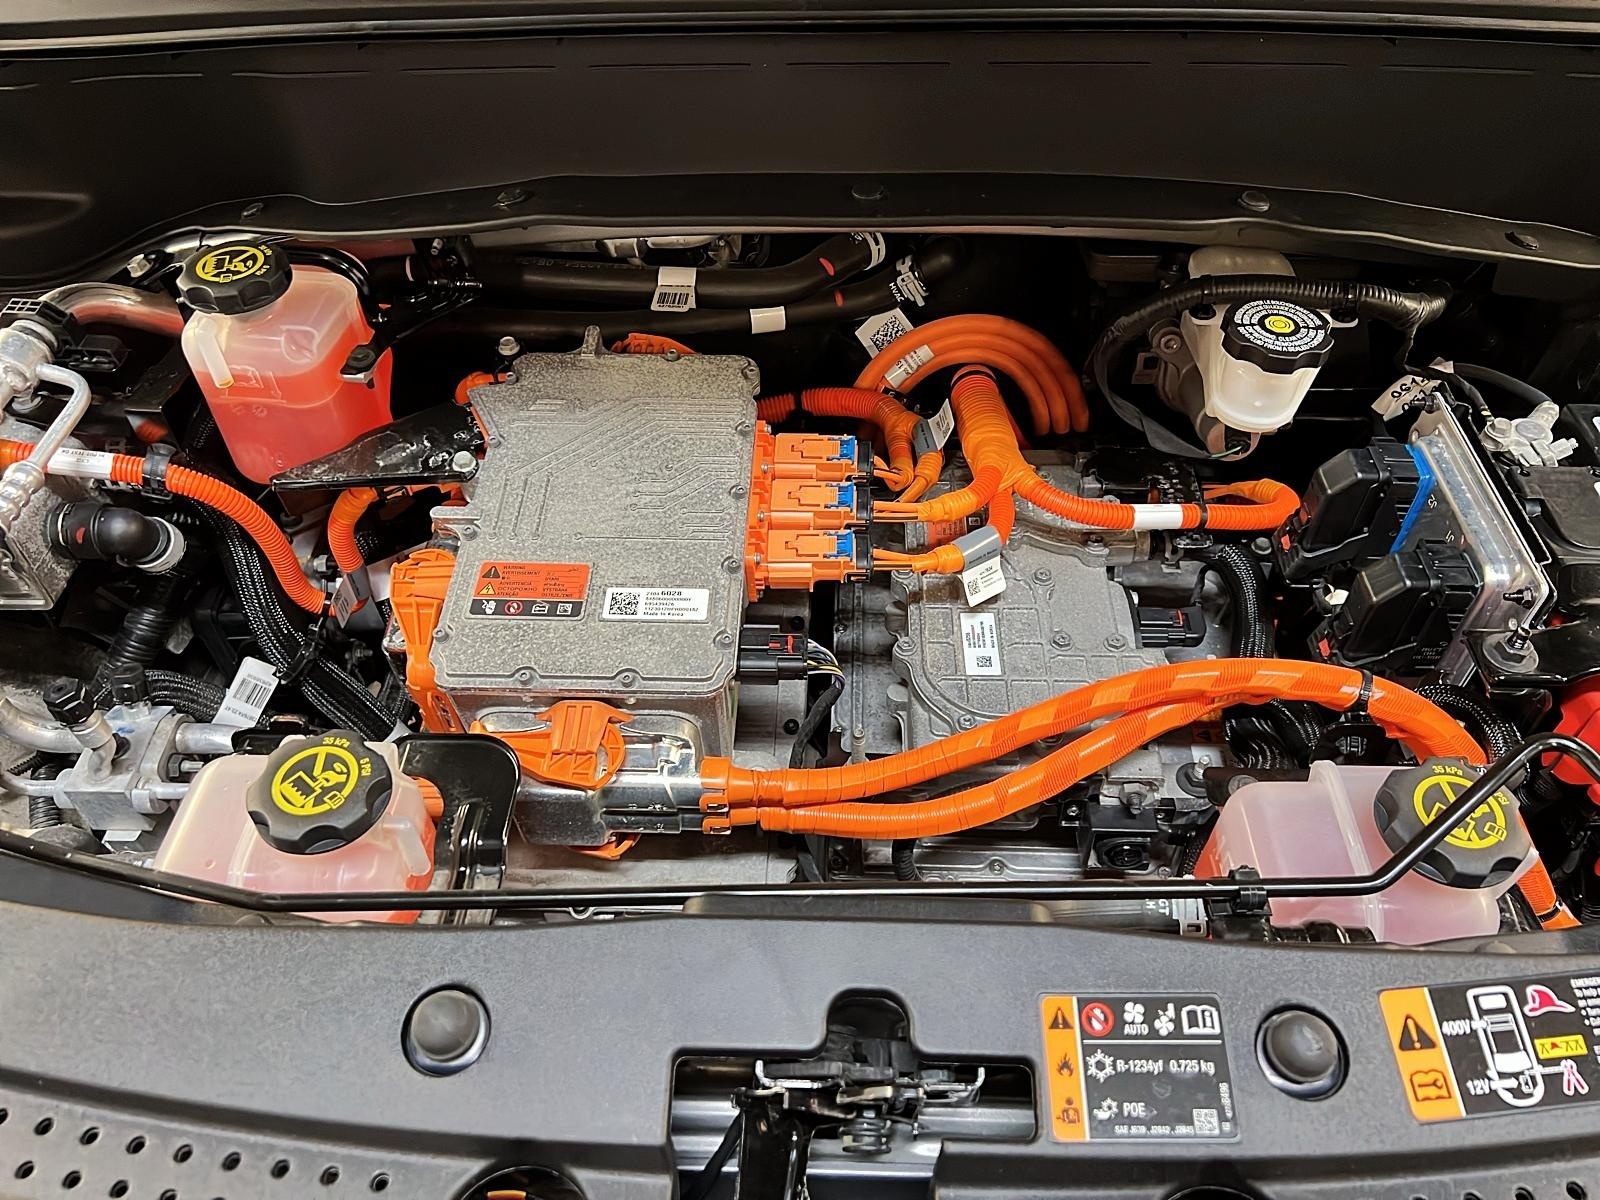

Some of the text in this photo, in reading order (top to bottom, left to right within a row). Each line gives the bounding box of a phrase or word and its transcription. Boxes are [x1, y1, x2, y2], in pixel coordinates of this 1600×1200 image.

[889, 282, 904, 302] HVAC
[323, 737, 350, 748] 35 kPa
[361, 763, 372, 777] PSI
[1432, 765, 1463, 776] 35 kPa
[1493, 791, 1510, 805] PSI
[1123, 1023, 1149, 1036] AUTO
[1441, 1019, 1471, 1037] 400V
[1116, 1060, 1215, 1076] R-1234yf 0.725 kg
[1466, 1079, 1490, 1096] 12V
[1123, 1102, 1146, 1116] POE
[1114, 1125, 1128, 1134] SAE
